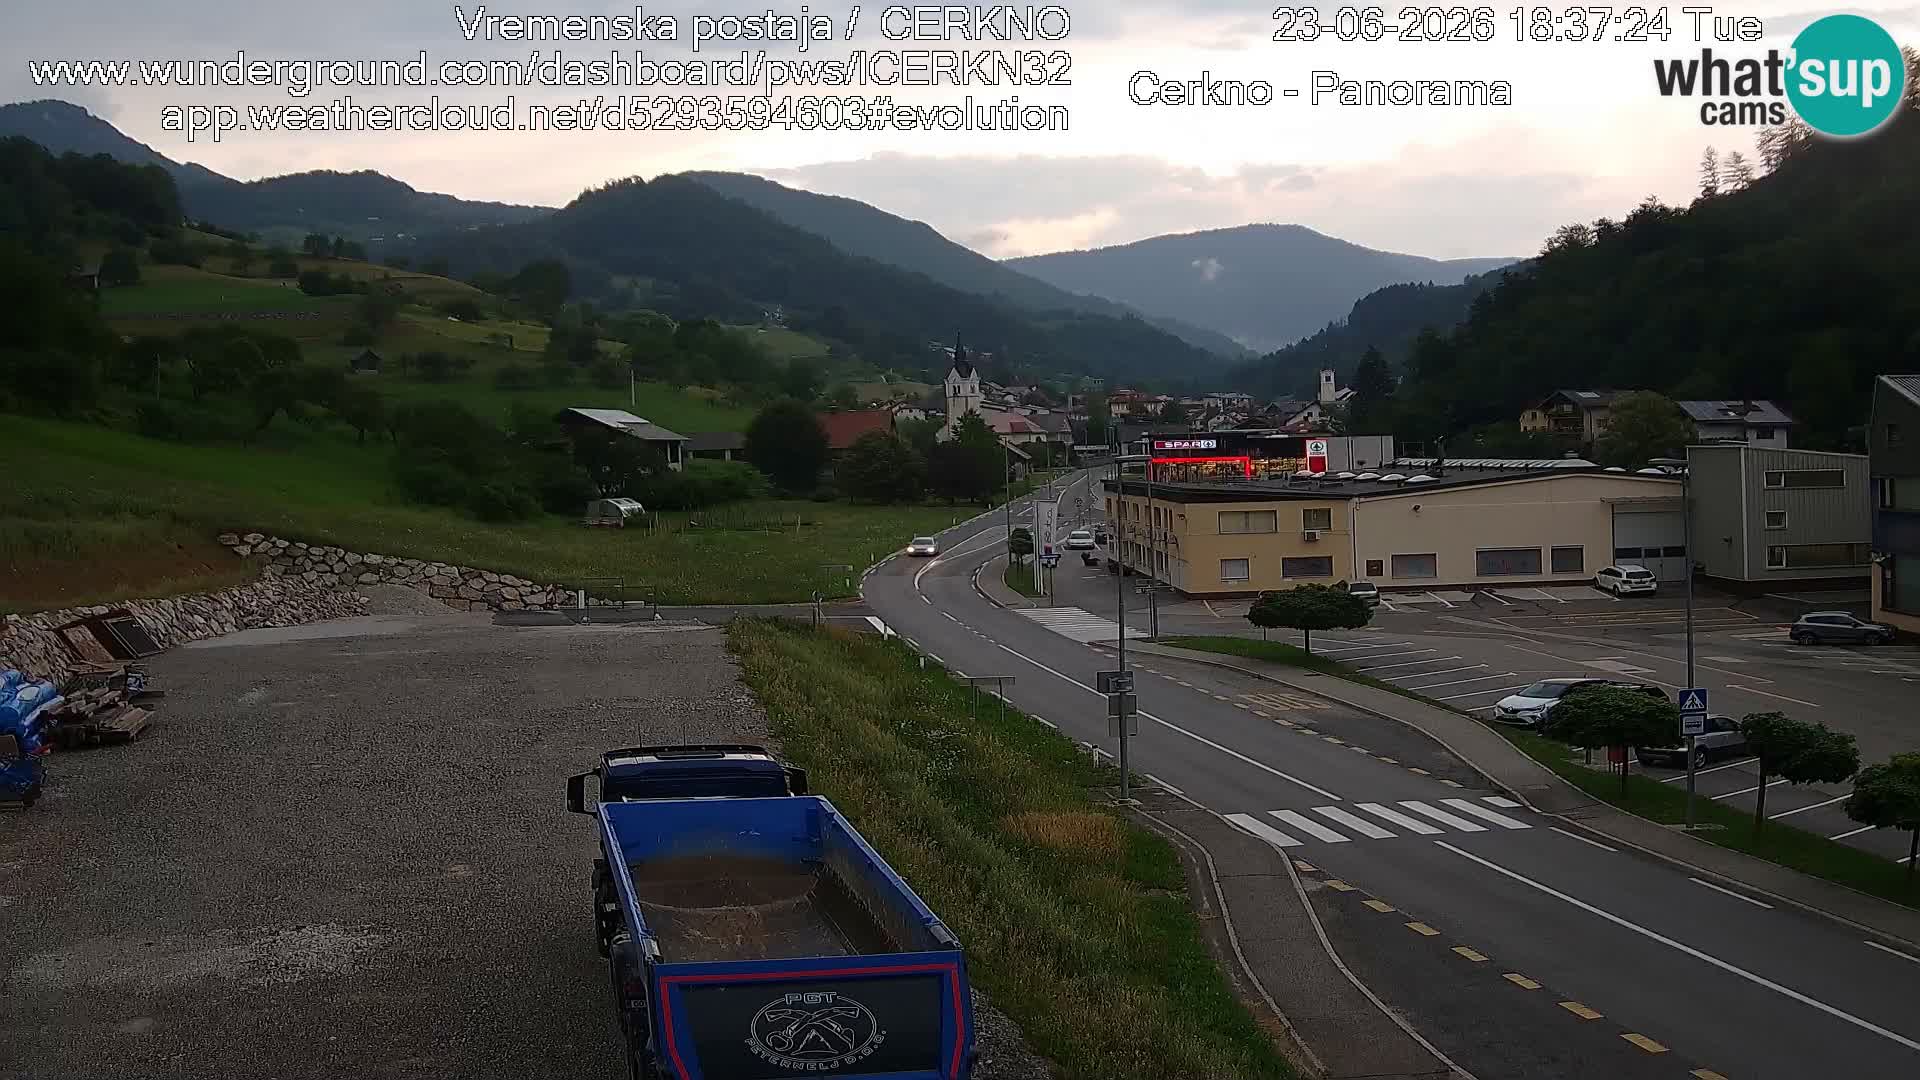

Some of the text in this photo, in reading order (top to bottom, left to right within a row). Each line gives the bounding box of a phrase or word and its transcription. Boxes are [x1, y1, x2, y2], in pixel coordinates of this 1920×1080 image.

[1165, 441, 1201, 449] SPAR
[784, 991, 838, 1006] PGT
[744, 1036, 840, 1072] PETERNELJ
